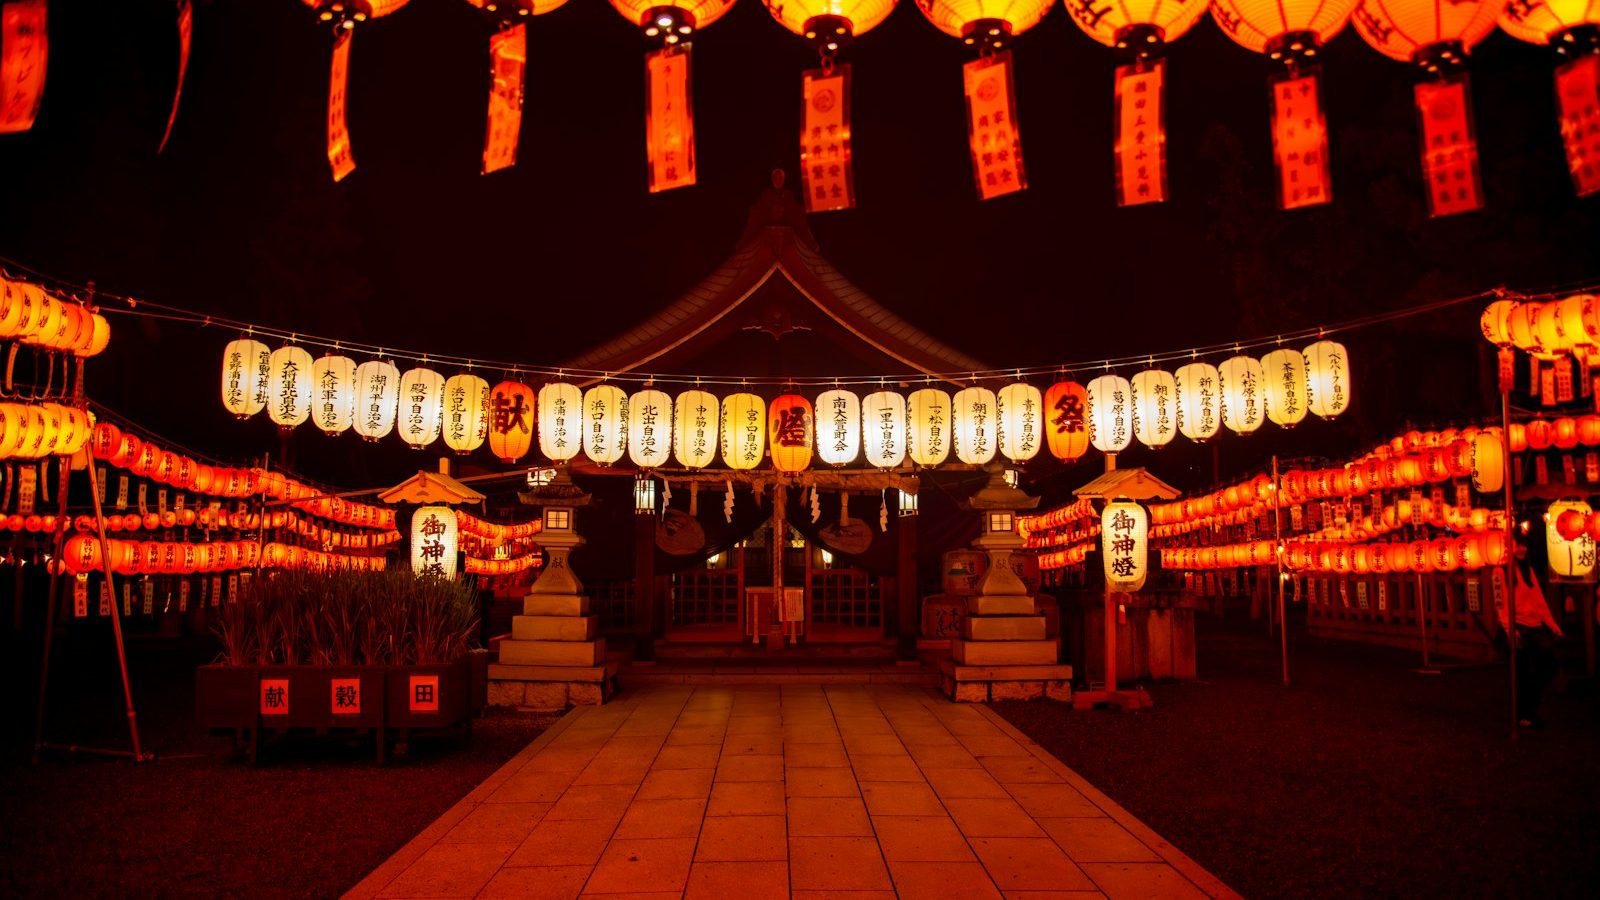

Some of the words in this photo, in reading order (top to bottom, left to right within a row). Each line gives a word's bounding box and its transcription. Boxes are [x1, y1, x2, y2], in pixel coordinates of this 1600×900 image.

[279, 360, 299, 420] 大将軍北自治会
[321, 370, 339, 428] 大将軍自治会
[365, 374, 387, 430] 湖州平自治会
[408, 383, 429, 435] 殿田自治会
[450, 386, 466, 440] 浜口北自治会
[491, 391, 530, 435] 献
[1051, 394, 1088, 434] 祭
[1241, 371, 1257, 424] 小松原自治会
[553, 398, 568, 448] 西浦自治会
[591, 400, 607, 454] 浜口自治会
[640, 404, 659, 457] 北出自治会
[692, 405, 707, 457] 中筋自治会
[832, 396, 849, 452] 南大萱町会
[878, 407, 896, 459] 一里山自治会
[1110, 509, 1137, 577] 御神燈
[265, 687, 285, 708] 献
[336, 686, 357, 707] 穀
[415, 684, 433, 703] 田
